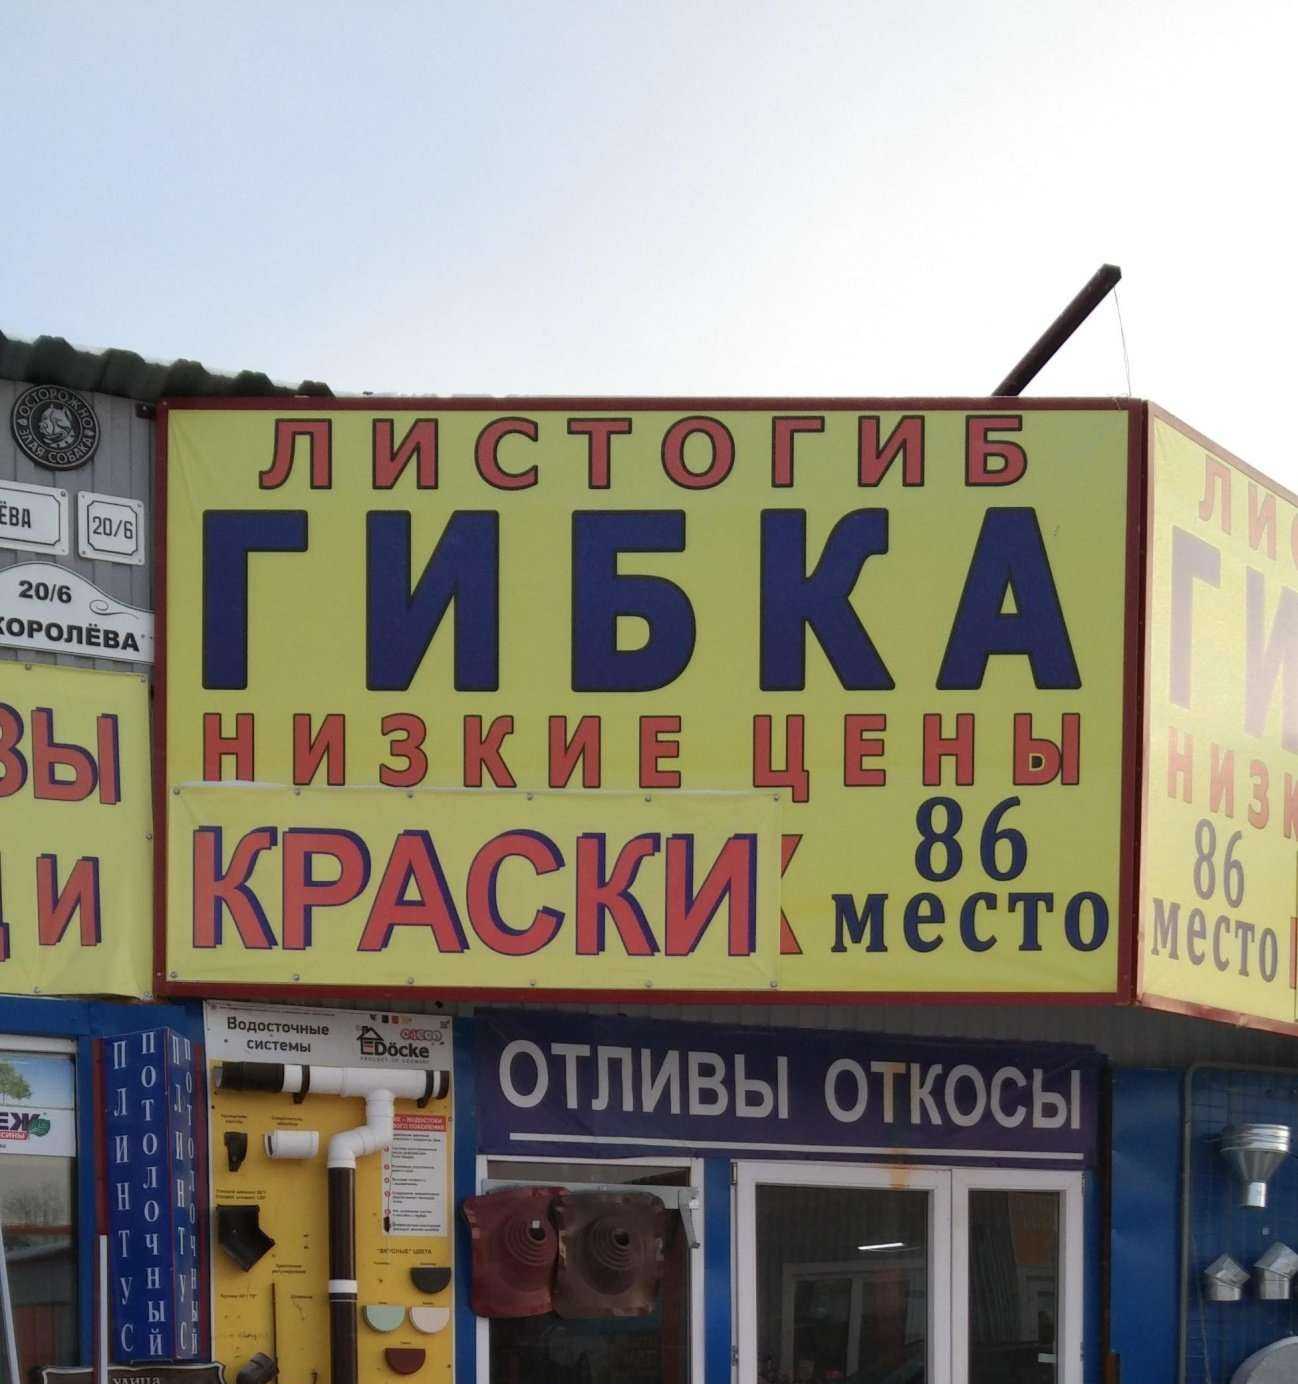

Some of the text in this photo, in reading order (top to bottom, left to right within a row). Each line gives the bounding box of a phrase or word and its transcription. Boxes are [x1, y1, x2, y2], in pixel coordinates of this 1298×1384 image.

[18, 386, 94, 428] ОСТОРОЖНО
[19, 428, 95, 465] ЗЛАЯ СОБАКА
[259, 415, 1028, 489] ЛИСТОГИБ
[92, 515, 134, 540] 20/6
[1199, 453, 1298, 573] ЛИ
[18, 579, 73, 604] 20/6
[202, 506, 1083, 693] ГИБКА
[202, 712, 1081, 803] НИЗКИЕ ЦЕНЫ
[914, 796, 1028, 882] 86
[1193, 818, 1245, 909] 86
[0, 853, 102, 963] И
[192, 825, 758, 957] КРАСКИ
[830, 890, 1110, 954] место
[1150, 897, 1279, 984] место
[226, 1015, 330, 1037] Водосточные
[246, 1038, 312, 1053] системы
[374, 1041, 430, 1058] Döcke
[498, 1039, 1081, 1130] ОТЛИВЫ ОТКОСЫ
[112, 1040, 134, 1352] ПЛИНТУС
[141, 1031, 165, 1356] ПОТОЛОЧНЫЙ
[171, 1036, 188, 1350] ПЛИНТУС
